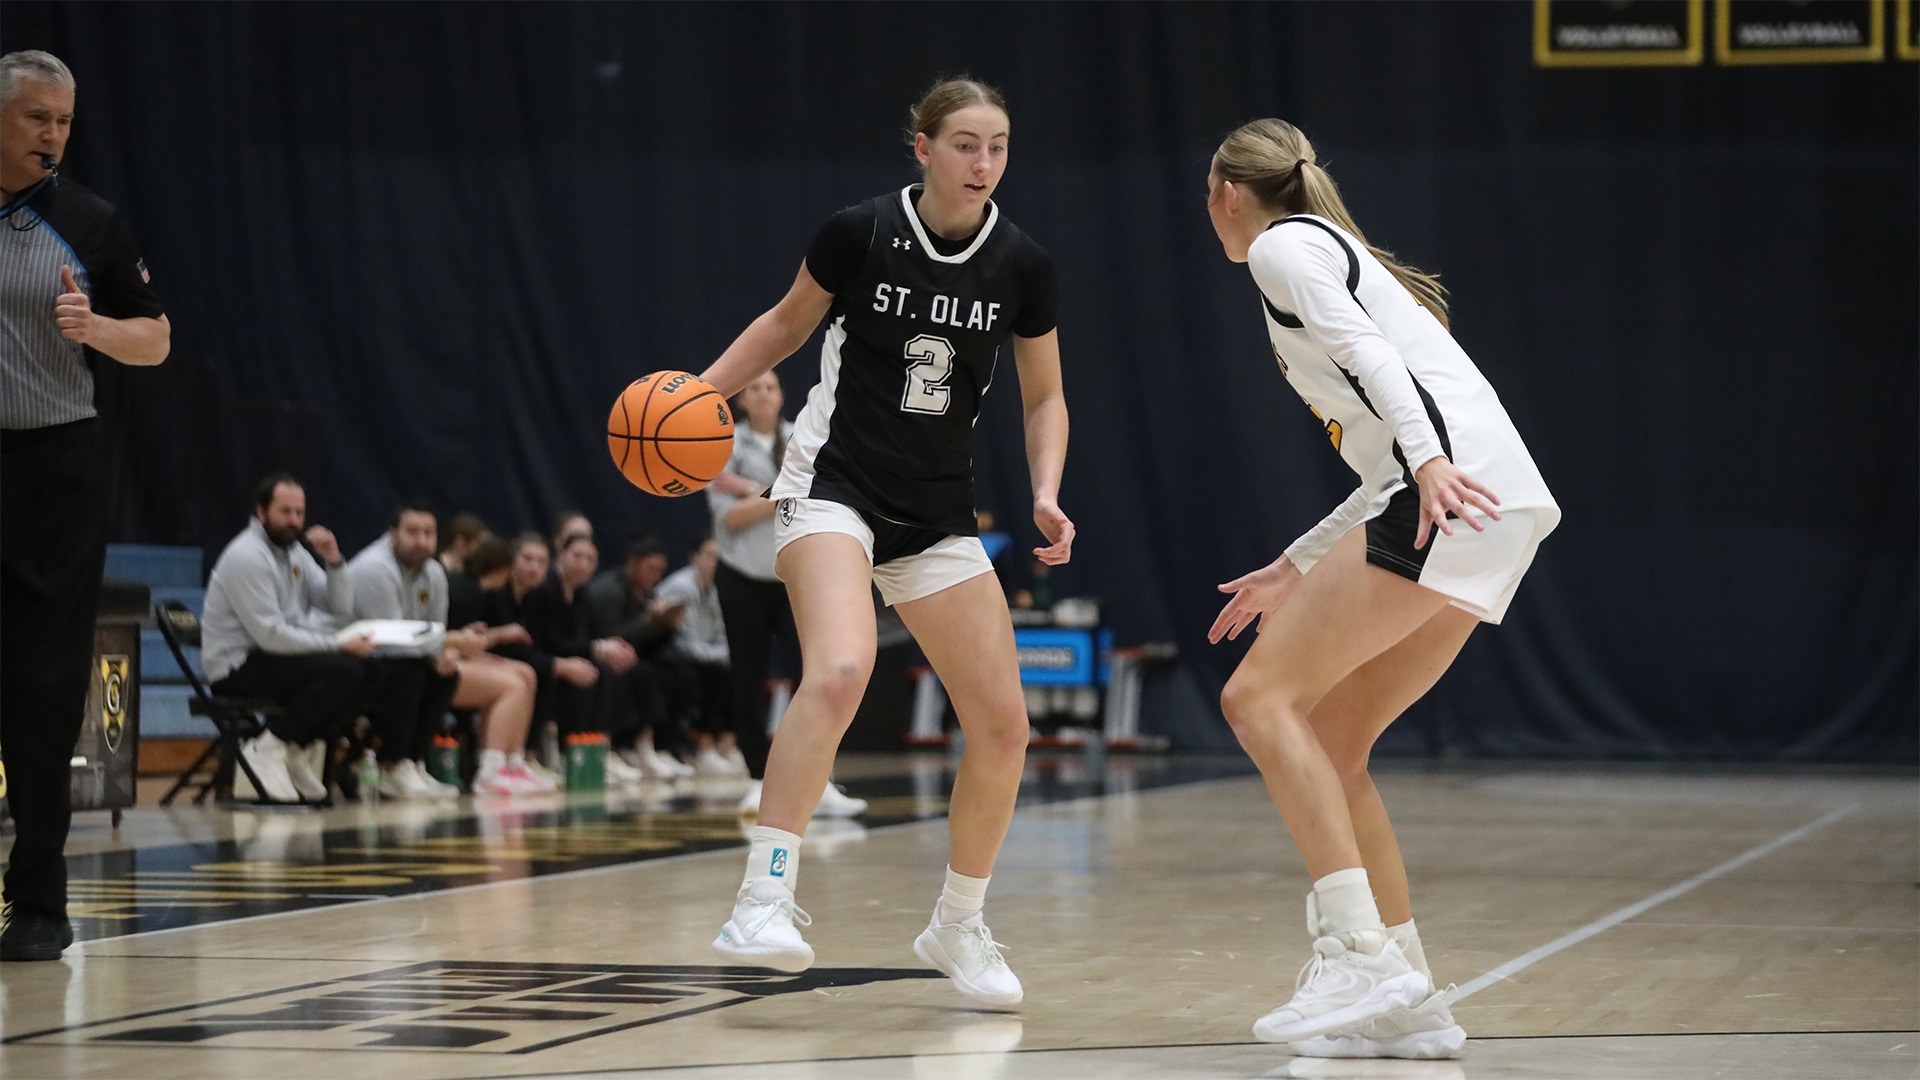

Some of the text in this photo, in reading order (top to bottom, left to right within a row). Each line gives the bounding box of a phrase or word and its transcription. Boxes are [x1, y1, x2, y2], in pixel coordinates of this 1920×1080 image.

[873, 282, 1001, 331] ST. OLAF
[900, 333, 956, 415] 2
